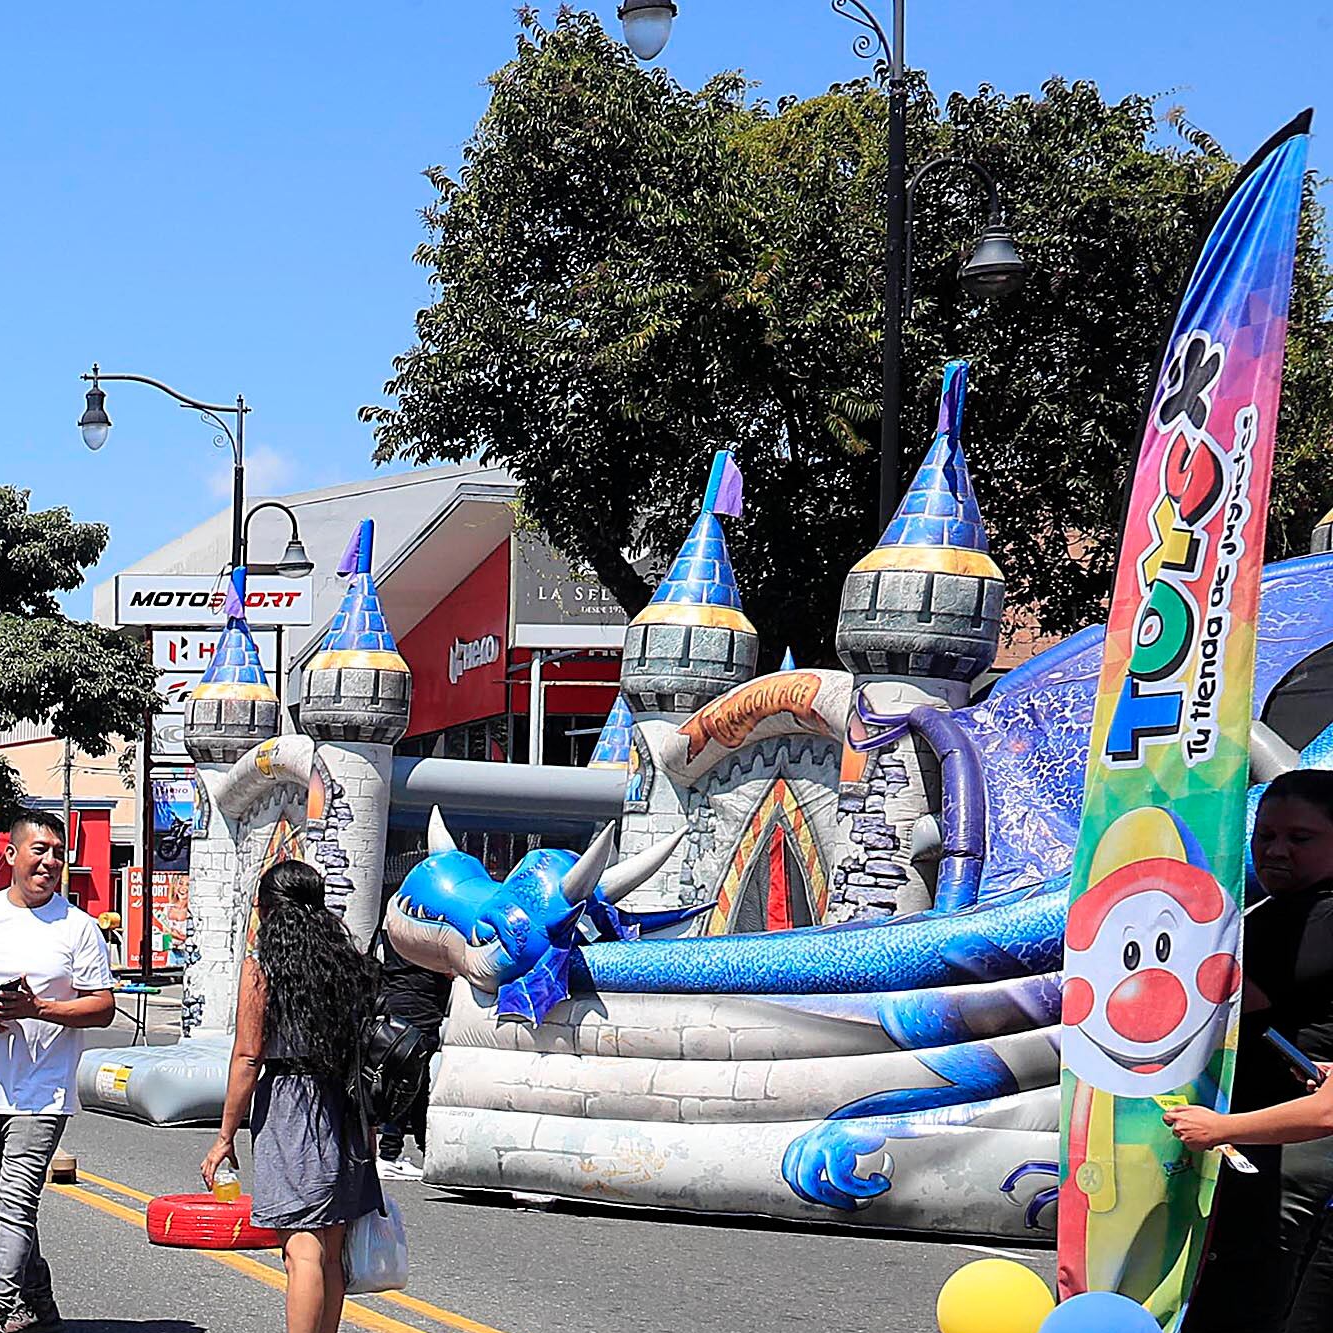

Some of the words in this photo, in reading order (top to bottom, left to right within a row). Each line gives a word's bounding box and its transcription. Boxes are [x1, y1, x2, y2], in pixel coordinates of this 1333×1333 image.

[129, 591, 302, 608] MOTOSORT
[538, 585, 561, 600] LA
[575, 586, 611, 601] SEL
[1106, 429, 1223, 762] TOYS
[1191, 614, 1223, 726] tienda
[1186, 727, 1211, 758] Tu
